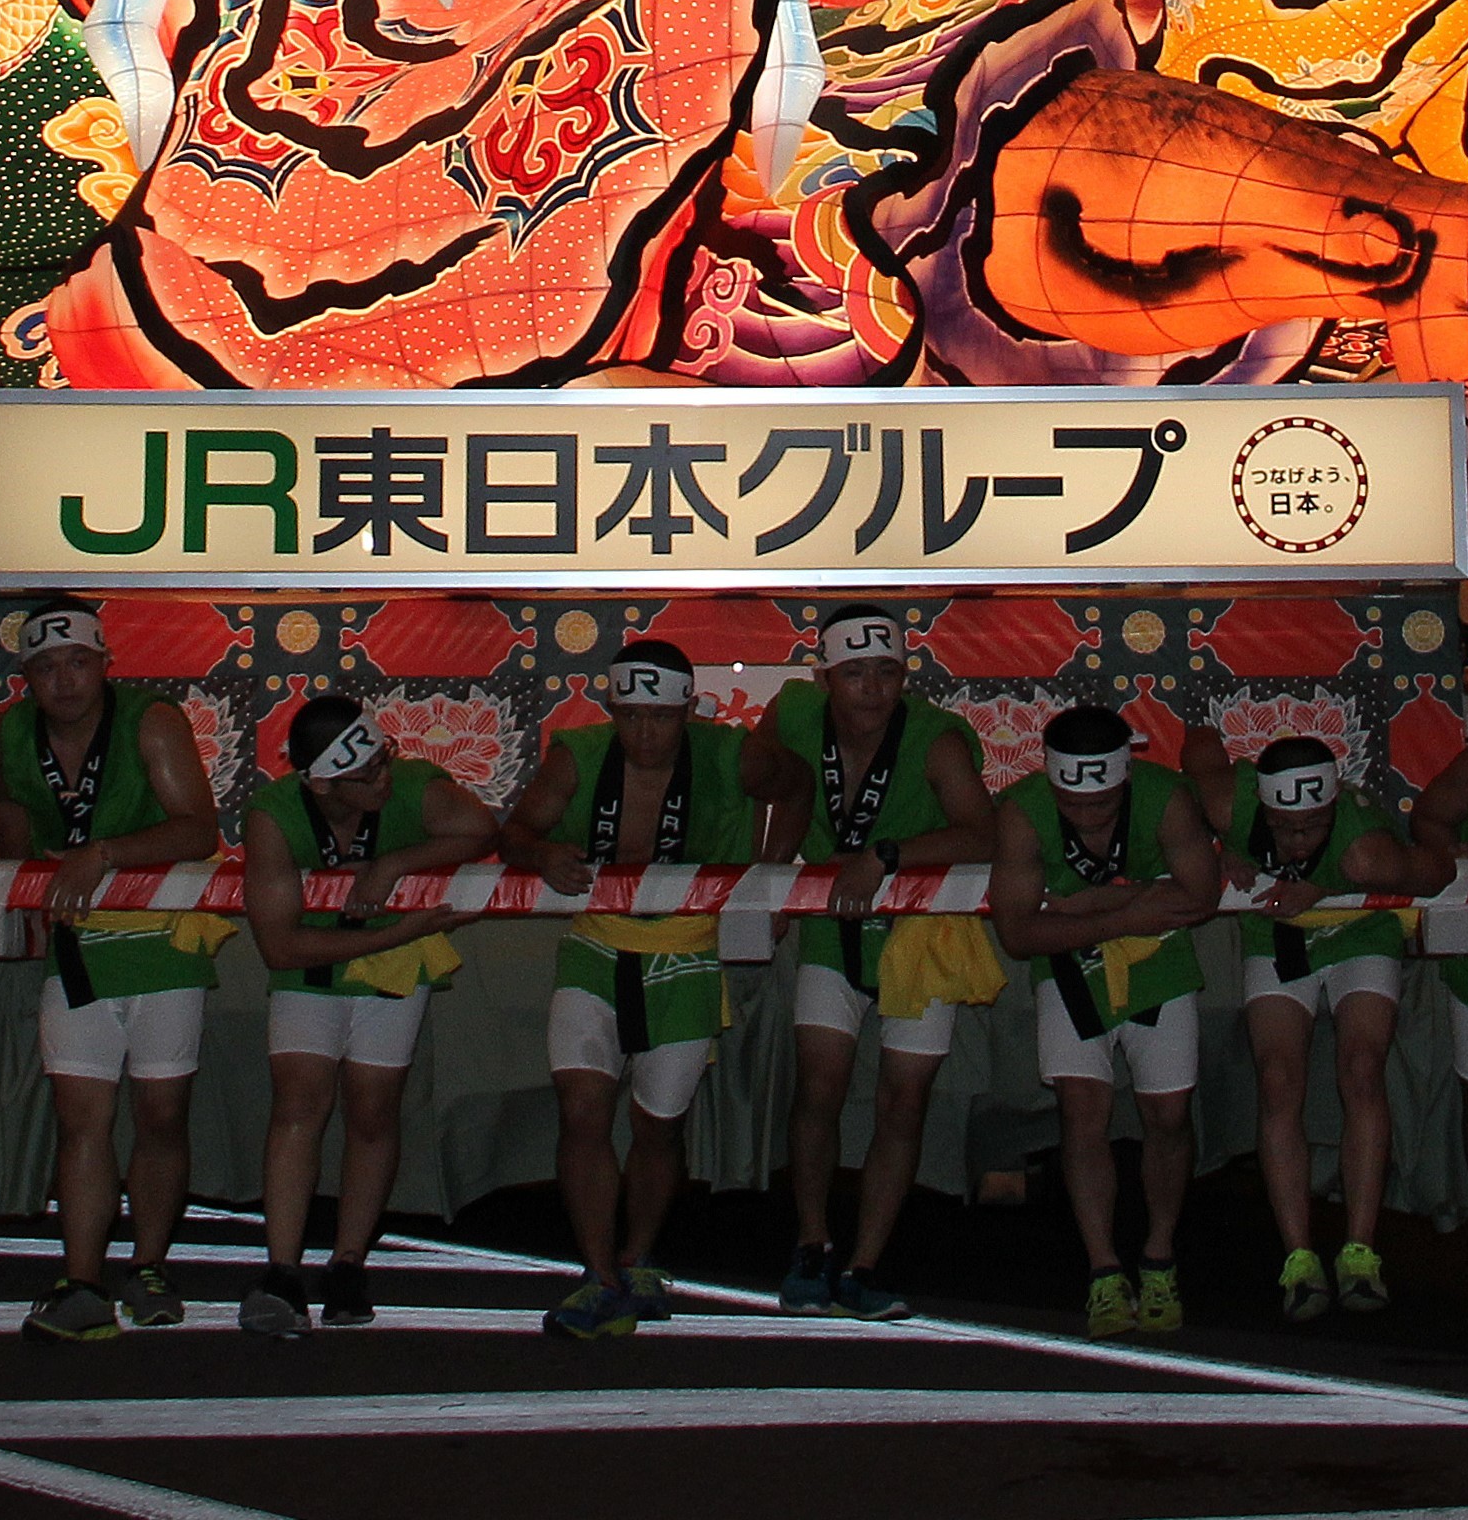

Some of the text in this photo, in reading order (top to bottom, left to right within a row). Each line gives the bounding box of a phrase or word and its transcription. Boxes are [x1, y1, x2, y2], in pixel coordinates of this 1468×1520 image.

[59, 418, 1188, 556] JR東日本グループ
[1271, 491, 1333, 515] 日本。
[29, 616, 71, 648] JR
[846, 625, 892, 649] JR
[617, 668, 660, 696] JR
[332, 725, 375, 769] JR
[1060, 760, 1106, 785] JR
[1276, 776, 1323, 805] JR
